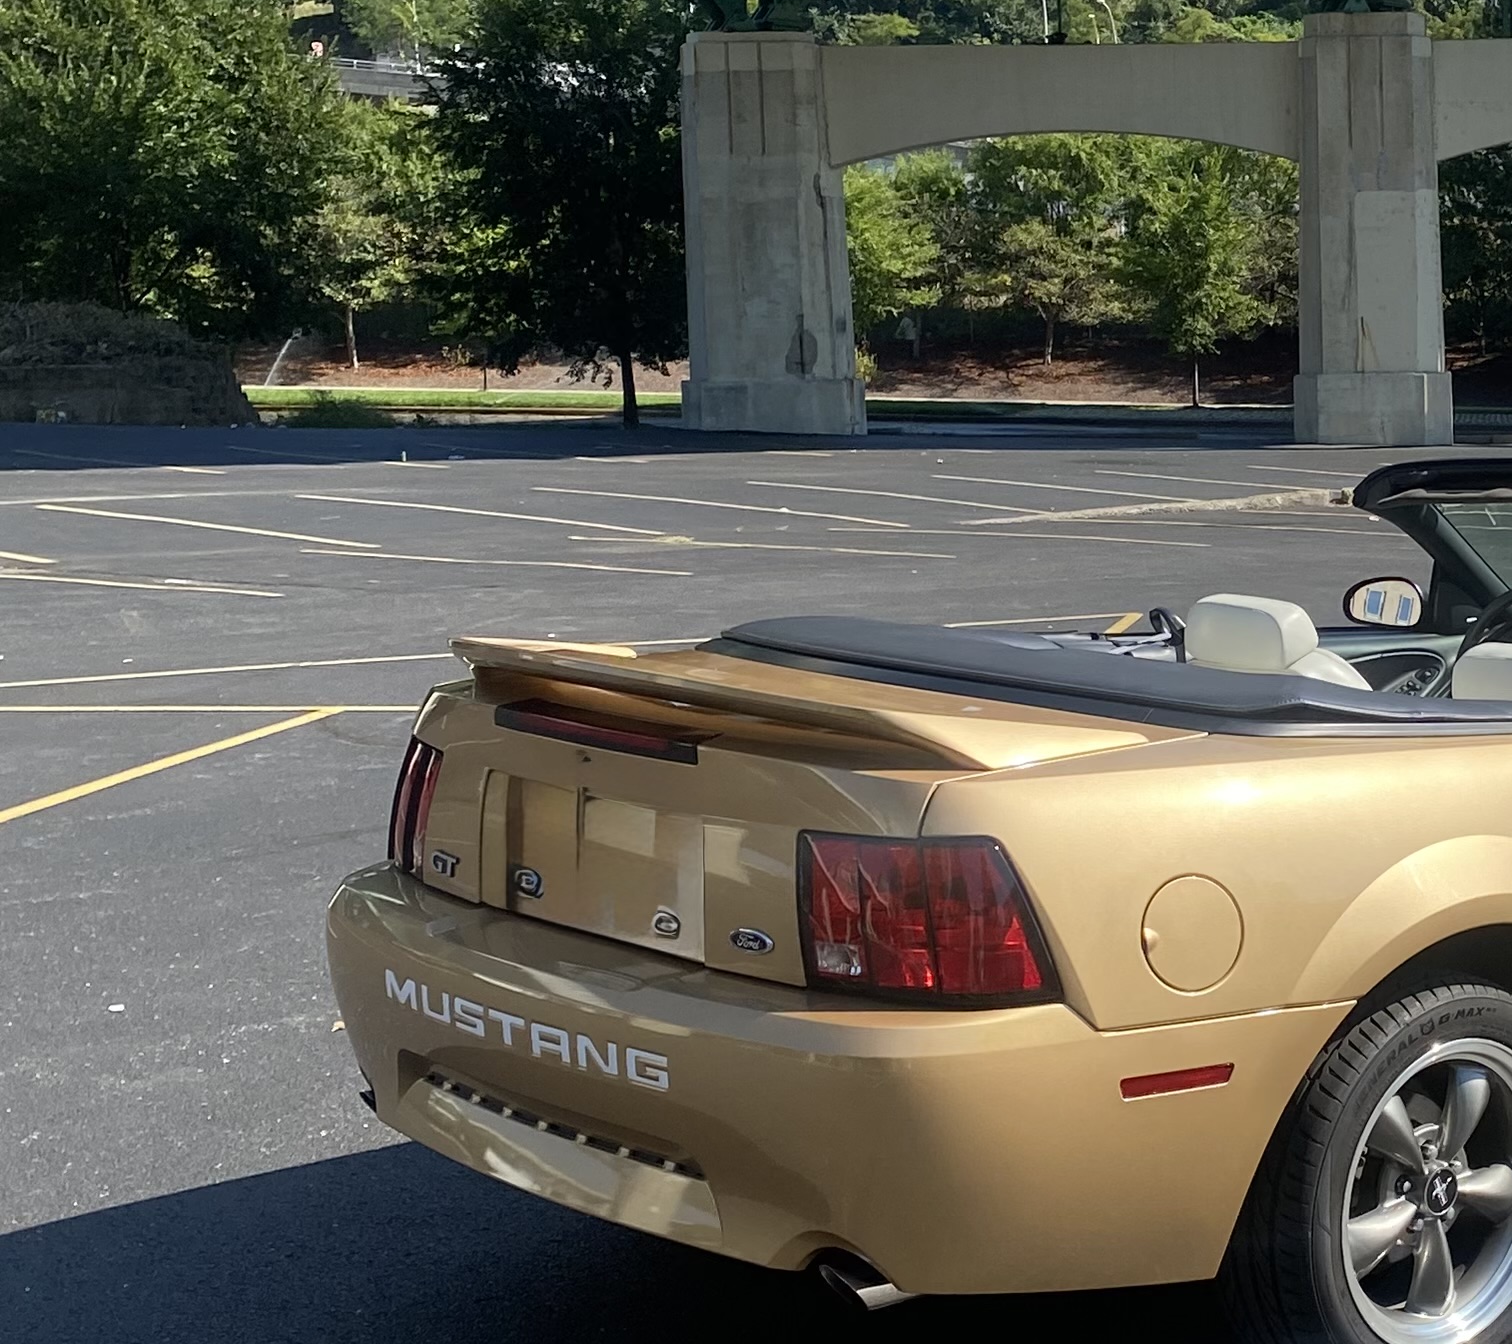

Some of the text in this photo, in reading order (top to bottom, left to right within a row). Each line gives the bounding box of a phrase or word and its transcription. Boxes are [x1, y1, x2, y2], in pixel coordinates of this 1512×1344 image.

[432, 849, 460, 877] GT
[736, 933, 761, 951] Ford
[385, 969, 670, 1092] MUSTANG
